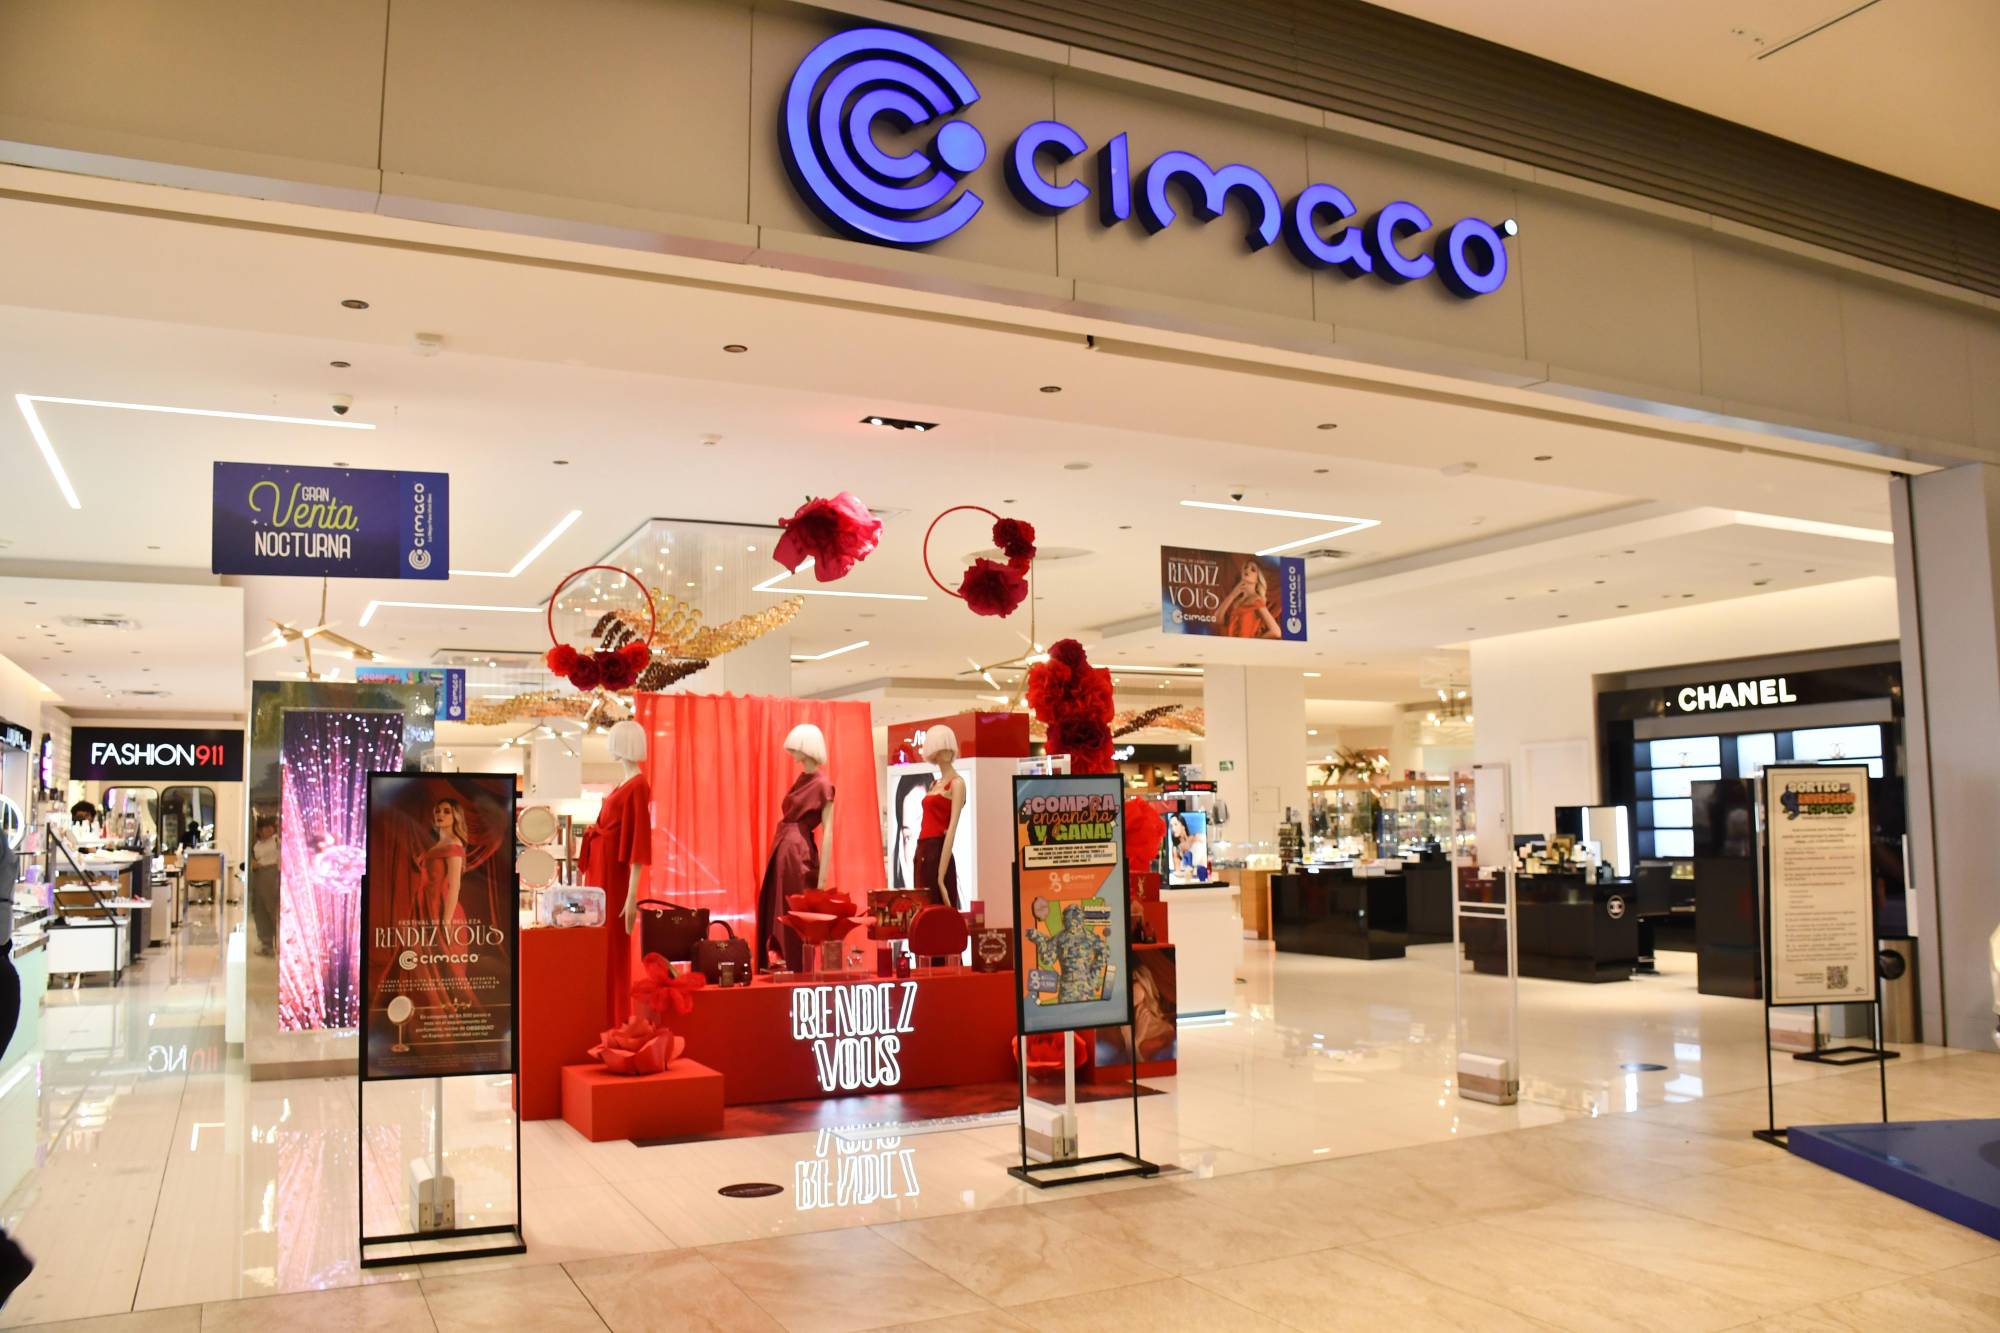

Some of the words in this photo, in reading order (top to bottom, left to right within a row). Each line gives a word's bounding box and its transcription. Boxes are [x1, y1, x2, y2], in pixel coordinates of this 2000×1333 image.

[1004, 119, 1508, 299] cimaco
[248, 480, 359, 530] Venta
[302, 486, 330, 502] GRAN
[414, 483, 425, 547] cimaco
[254, 531, 351, 560] NOCTURNA
[1168, 562, 1220, 587] RENDEZ
[1168, 585, 1220, 610] VOUS
[1288, 566, 1298, 616] cimaco
[1184, 613, 1217, 623] cimaco
[1677, 677, 1797, 712] CHANEL
[91, 742, 225, 767] FASHION911
[1787, 781, 1841, 794] SORTEO
[1034, 825, 1048, 842] Y
[1053, 822, 1113, 842] GANA!
[375, 926, 439, 949] RENDEZ
[443, 925, 505, 946] VOUS
[420, 953, 480, 964] cimaco
[792, 981, 918, 1041] RENDEZ
[813, 1035, 901, 1092] VOUS
